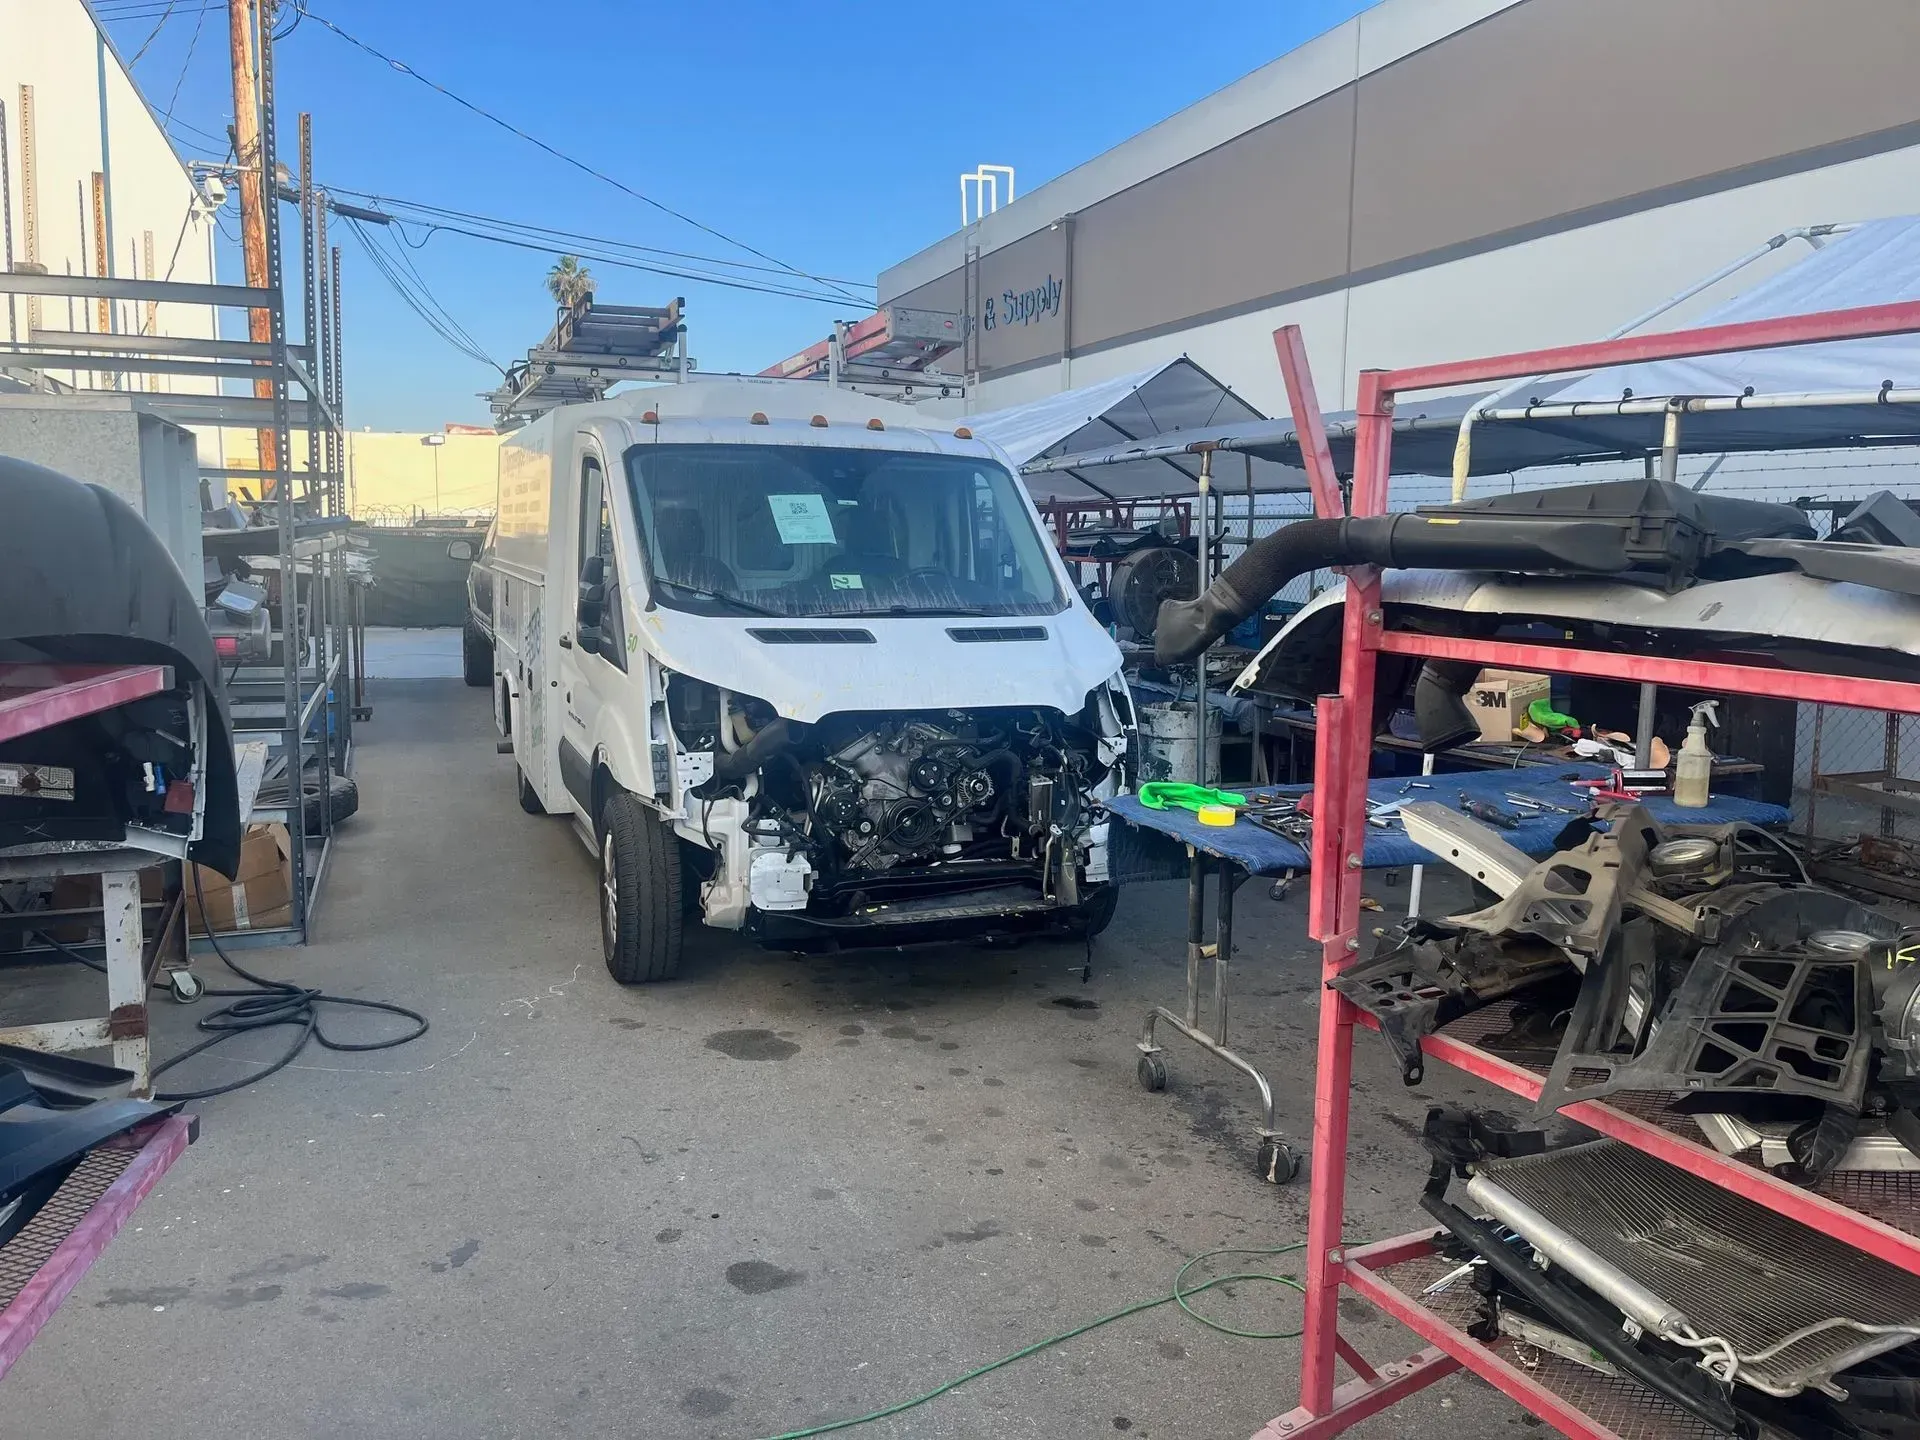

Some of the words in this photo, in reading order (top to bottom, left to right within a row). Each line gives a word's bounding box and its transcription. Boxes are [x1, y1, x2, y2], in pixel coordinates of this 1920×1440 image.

[984, 297, 997, 331] &
[1002, 274, 1063, 327] Supply
[1476, 690, 1507, 709] 3M
